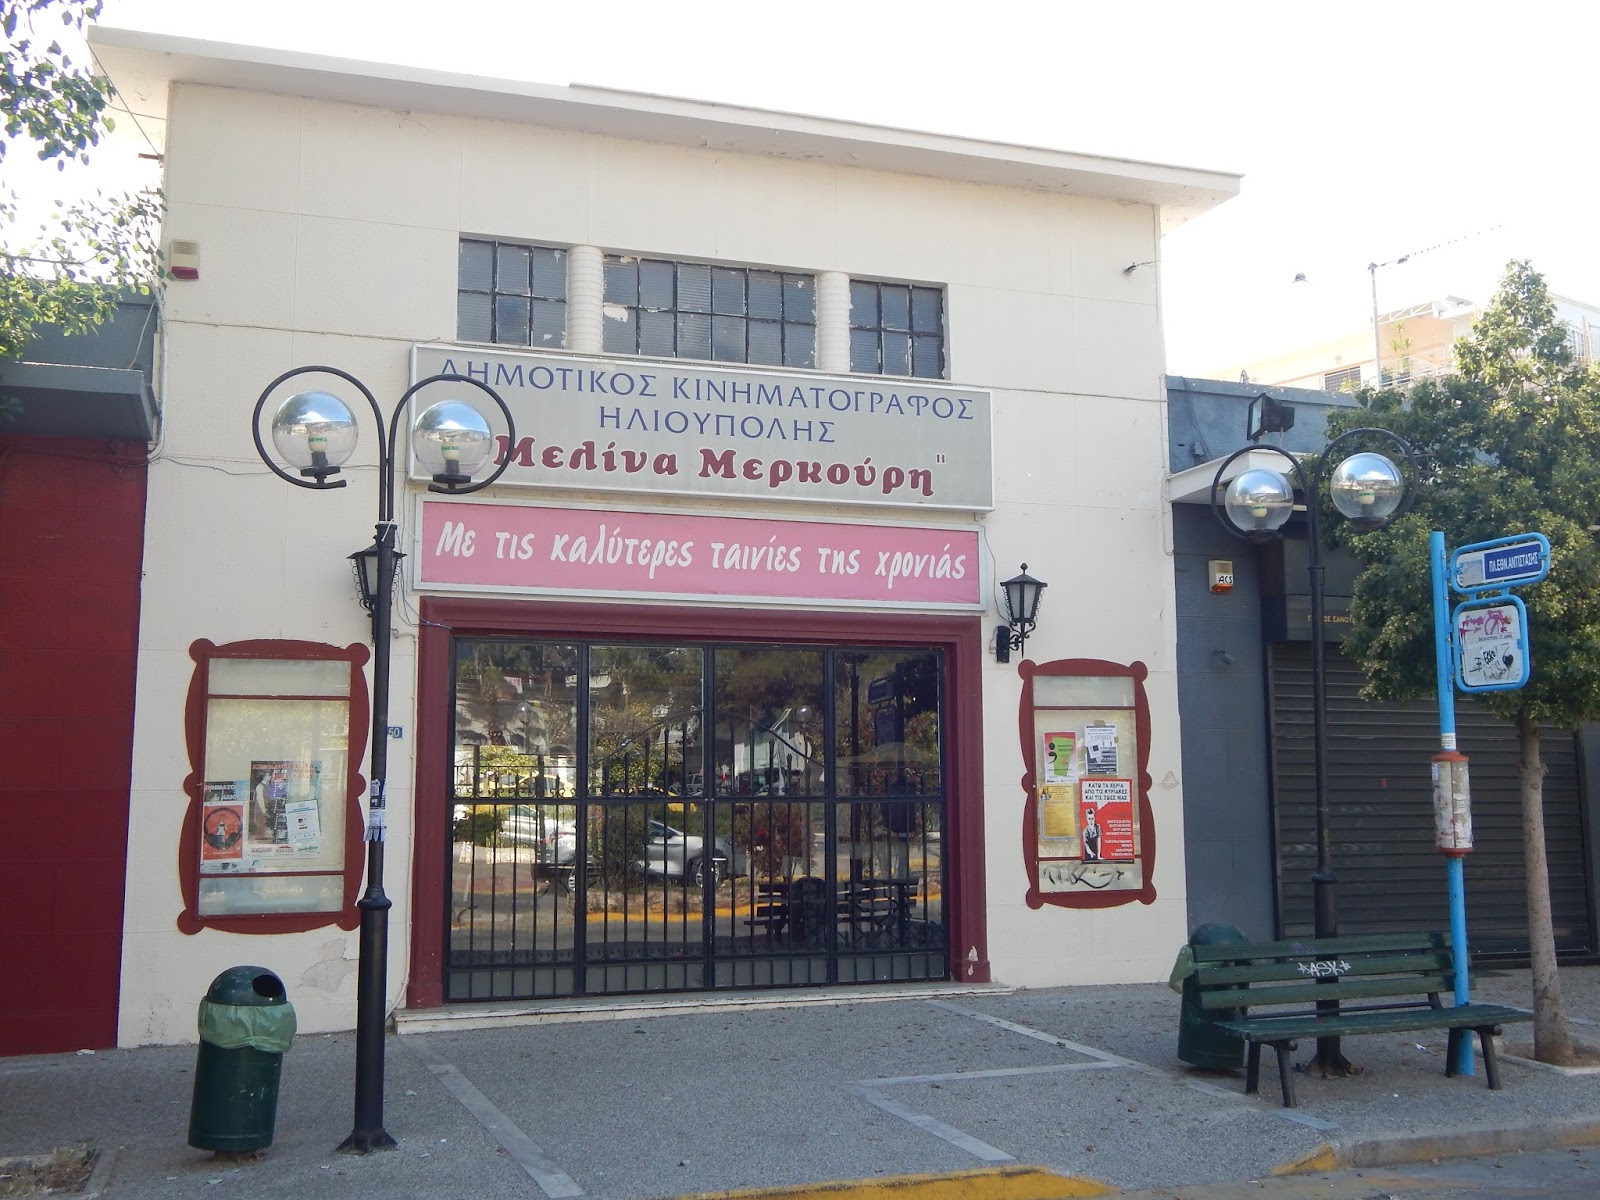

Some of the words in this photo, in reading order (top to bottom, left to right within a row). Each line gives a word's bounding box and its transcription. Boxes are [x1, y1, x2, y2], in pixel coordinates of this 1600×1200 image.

[440, 359, 657, 397] ΔΗΜΟΤΙΚΟΣ
[673, 376, 974, 420] ΚΙΝΗΜΑΤΟΓΡΑΦΟΣ
[600, 406, 836, 443] ΗΛΙΟΥΠΟΛΗΣ
[435, 521, 477, 558] Με
[495, 531, 535, 561] τις
[550, 523, 694, 580] καλύτερες
[711, 535, 802, 572] ταινίες
[818, 547, 861, 575] της
[874, 543, 967, 589] χρονιάς
[388, 727, 400, 738] 50
